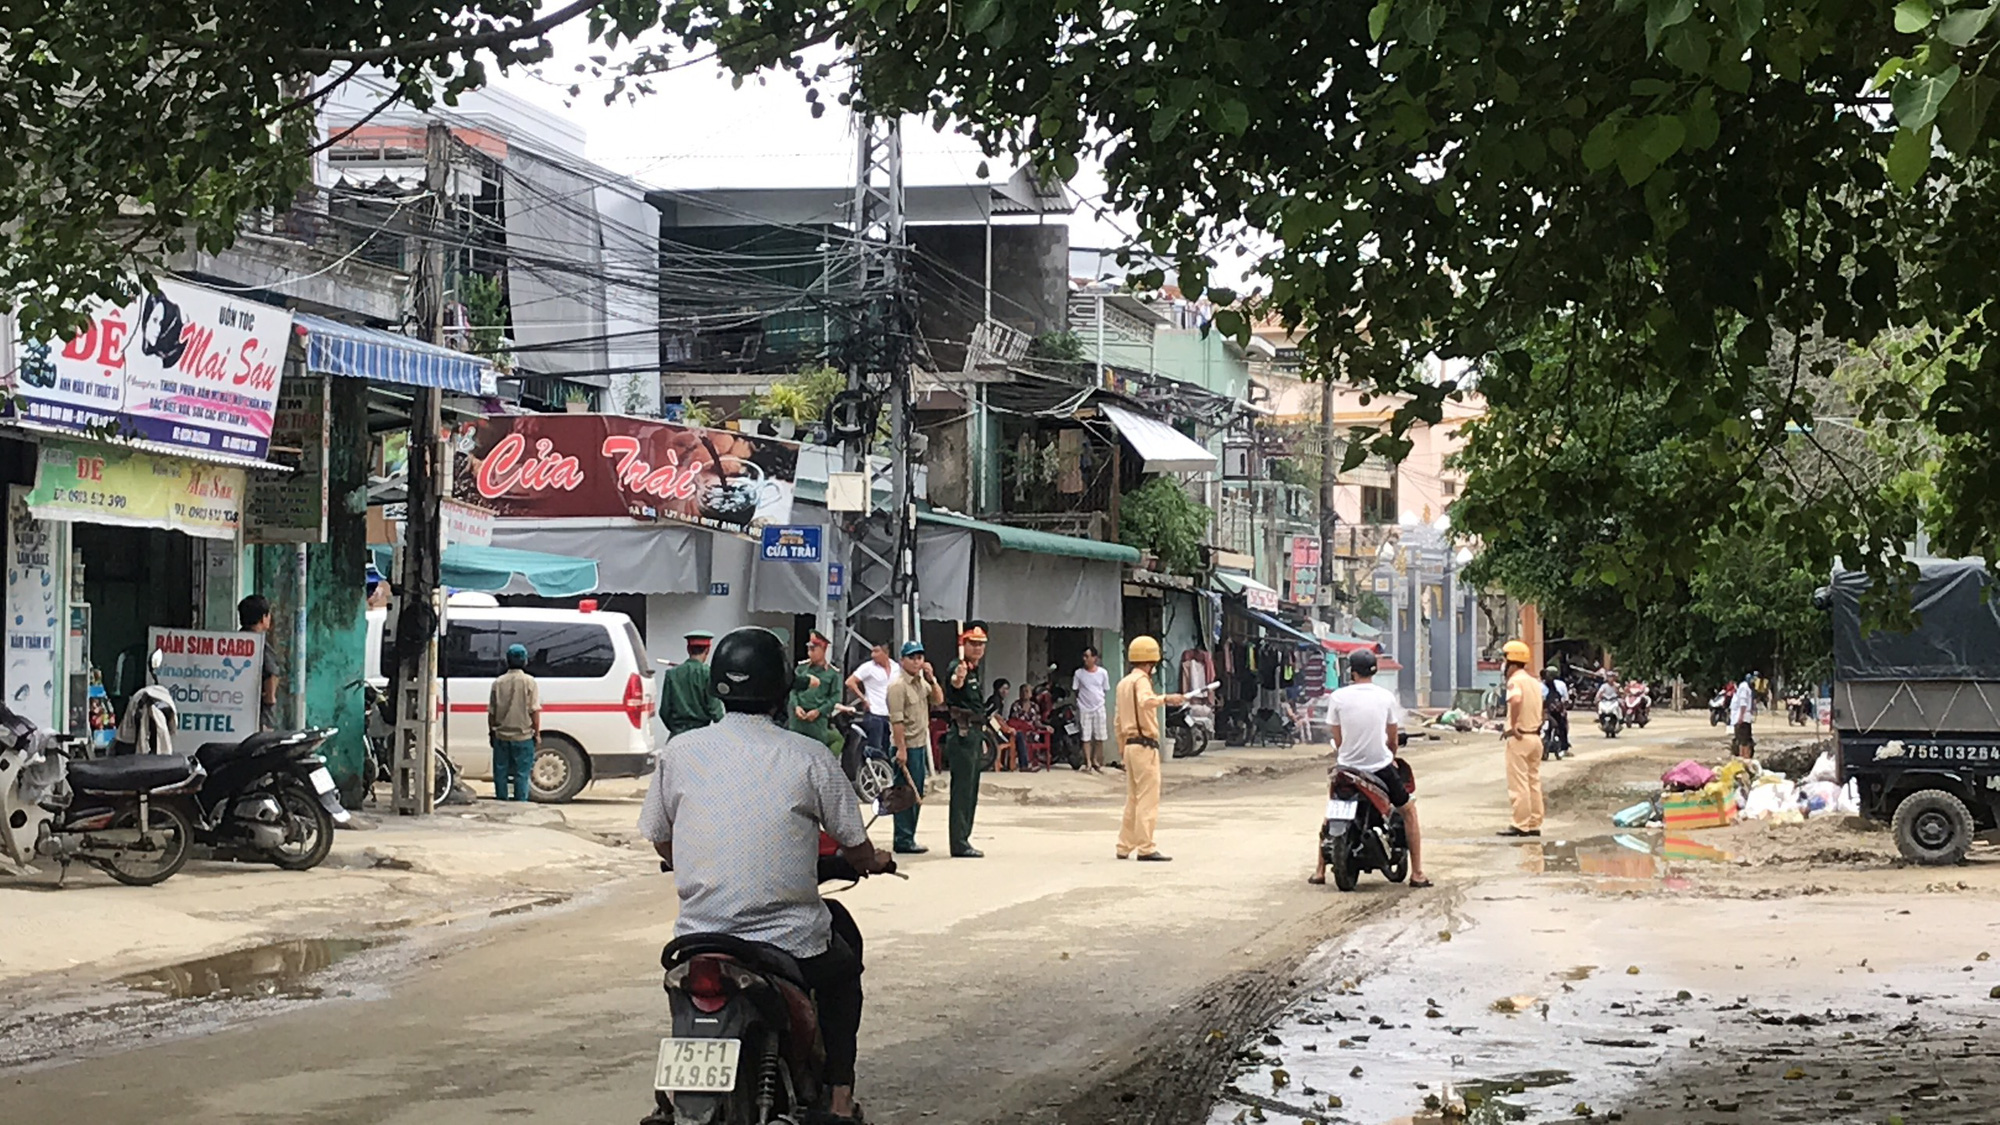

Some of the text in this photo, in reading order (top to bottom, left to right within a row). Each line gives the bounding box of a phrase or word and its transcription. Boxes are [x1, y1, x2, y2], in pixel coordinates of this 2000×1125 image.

[179, 321, 231, 381] Mai
[477, 433, 584, 499] Cửa
[766, 542, 789, 557] CỬA
[156, 631, 185, 654] BÁN
[187, 635, 214, 656] SIM
[155, 663, 229, 680] vinaphone
[177, 713, 235, 733] IETTEL
[673, 1041, 727, 1063] 75-F1
[664, 1065, 733, 1088] 149.65
